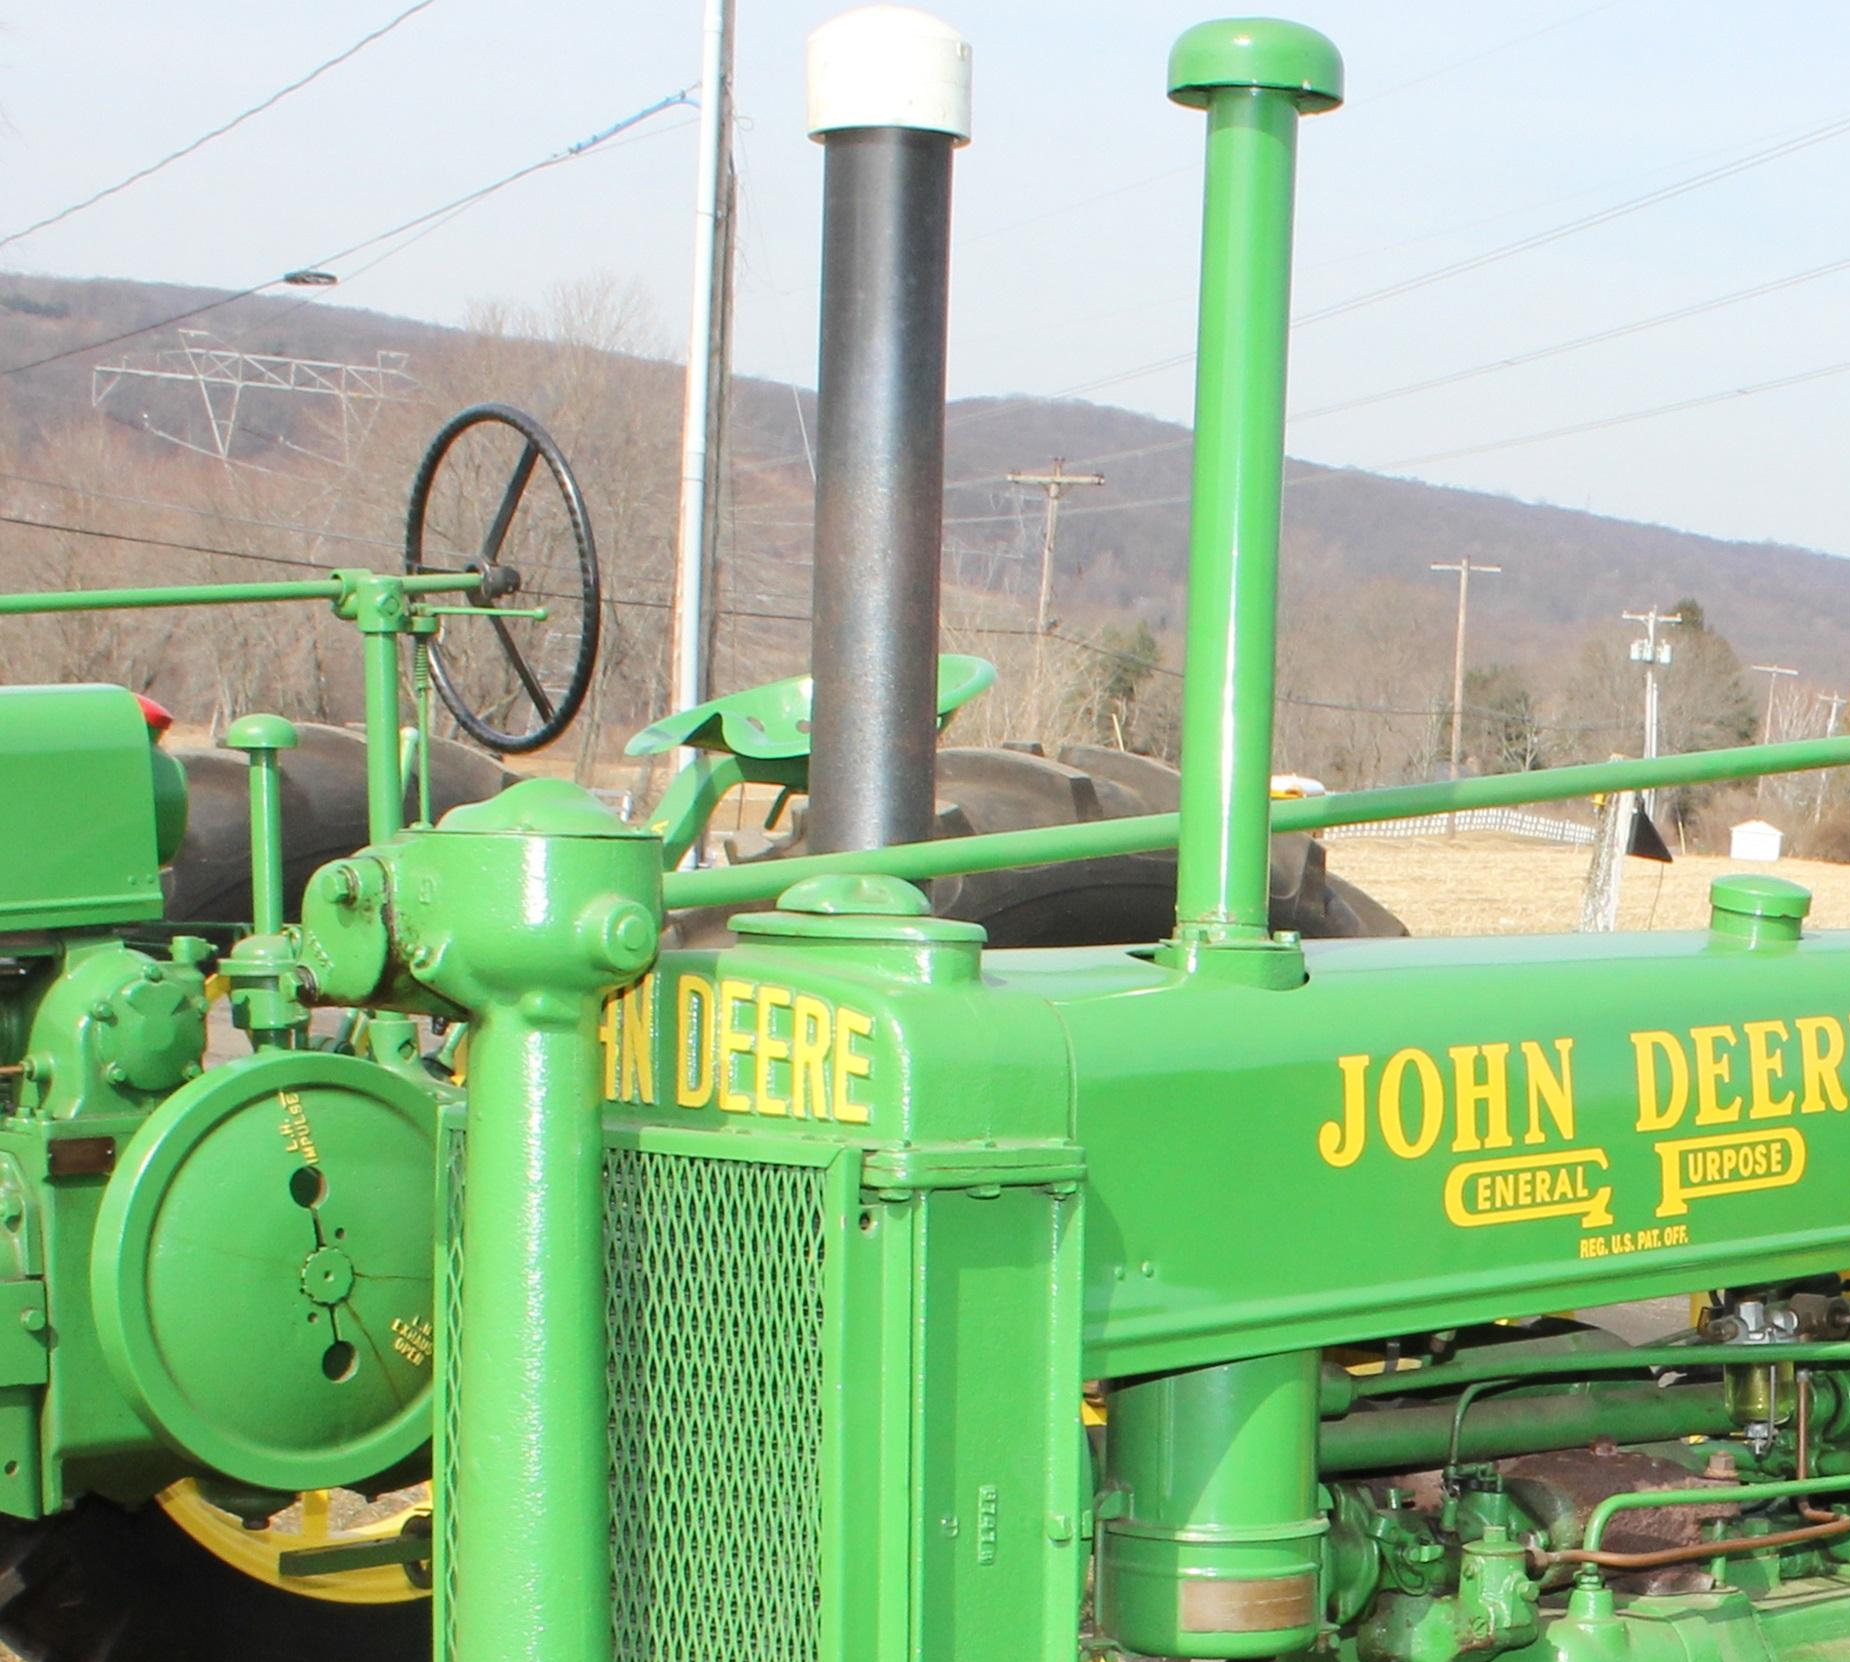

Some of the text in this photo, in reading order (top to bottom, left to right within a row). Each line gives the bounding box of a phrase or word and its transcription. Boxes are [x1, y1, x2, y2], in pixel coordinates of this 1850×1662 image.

[599, 973, 871, 1123] HN DEERE
[286, 1092, 320, 1165] IMPULSE
[1317, 1036, 1575, 1168] JOHN
[1579, 1224, 1689, 1259] REG. U.S. PAT. OFF.
[391, 1317, 433, 1356] EXHAUS
